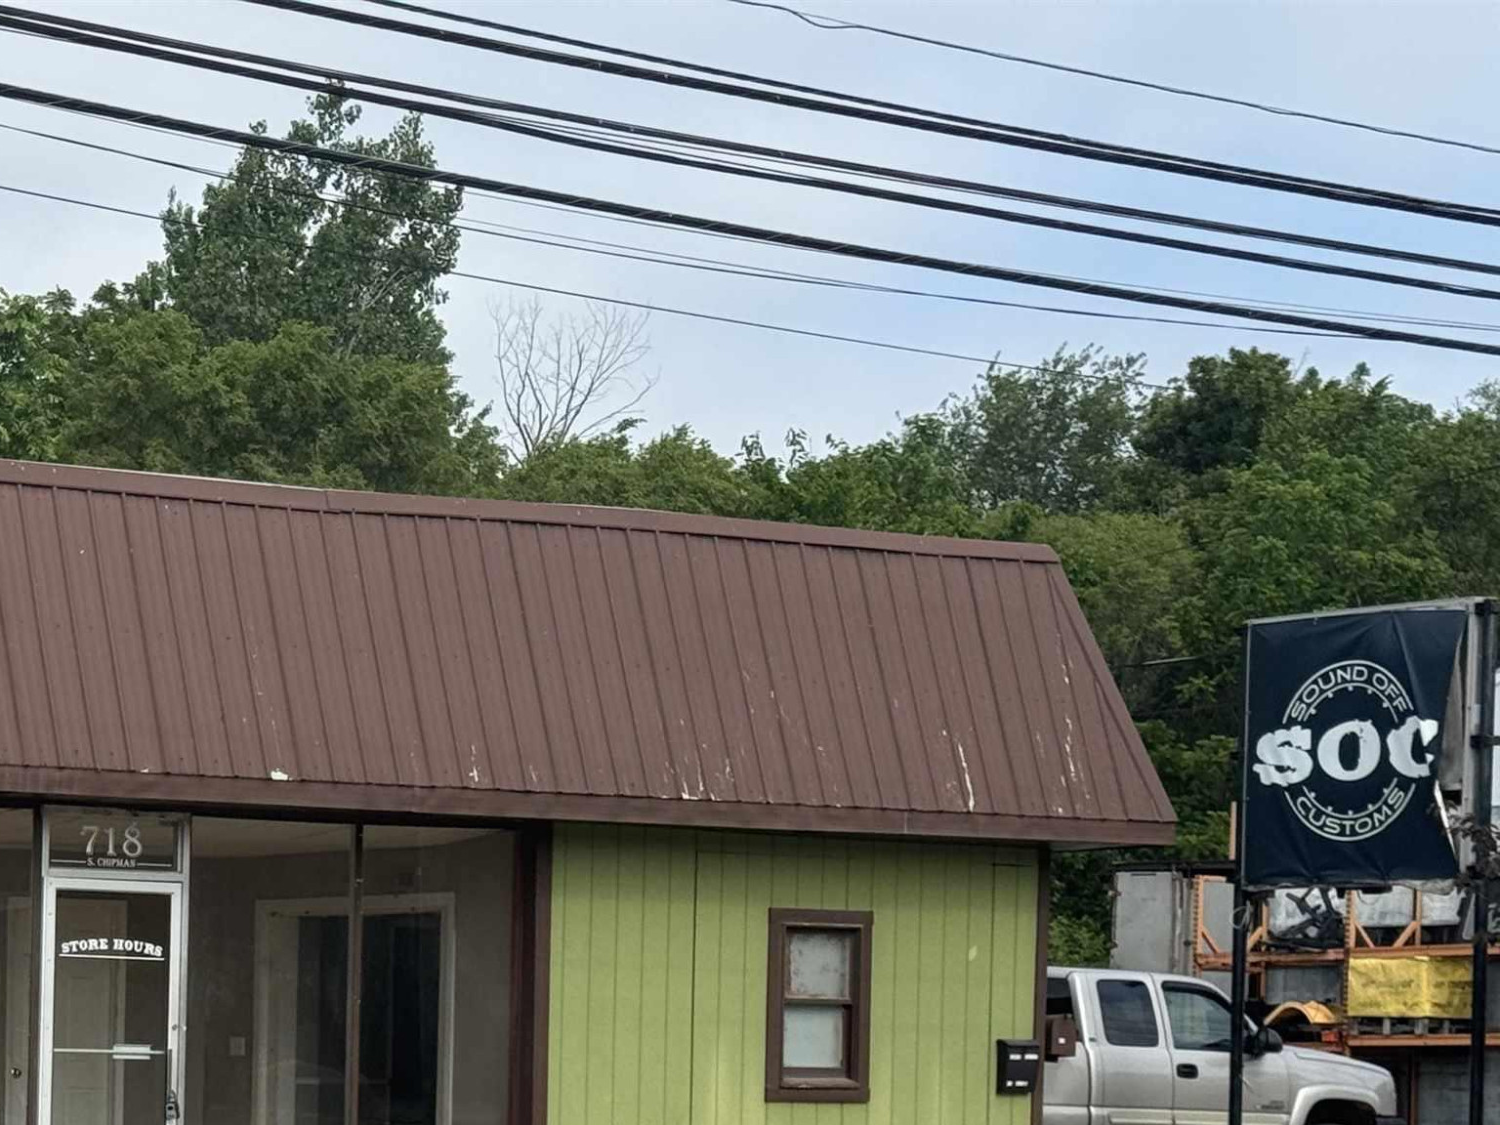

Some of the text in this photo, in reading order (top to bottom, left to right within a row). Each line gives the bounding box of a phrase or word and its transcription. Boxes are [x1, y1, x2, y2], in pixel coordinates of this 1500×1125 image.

[1291, 666, 1408, 719] SOUND OFF
[1252, 715, 1439, 787] SOC
[1296, 787, 1405, 834] CUSTOMS
[80, 823, 142, 858] 718
[61, 938, 164, 957] STORE HOURS
